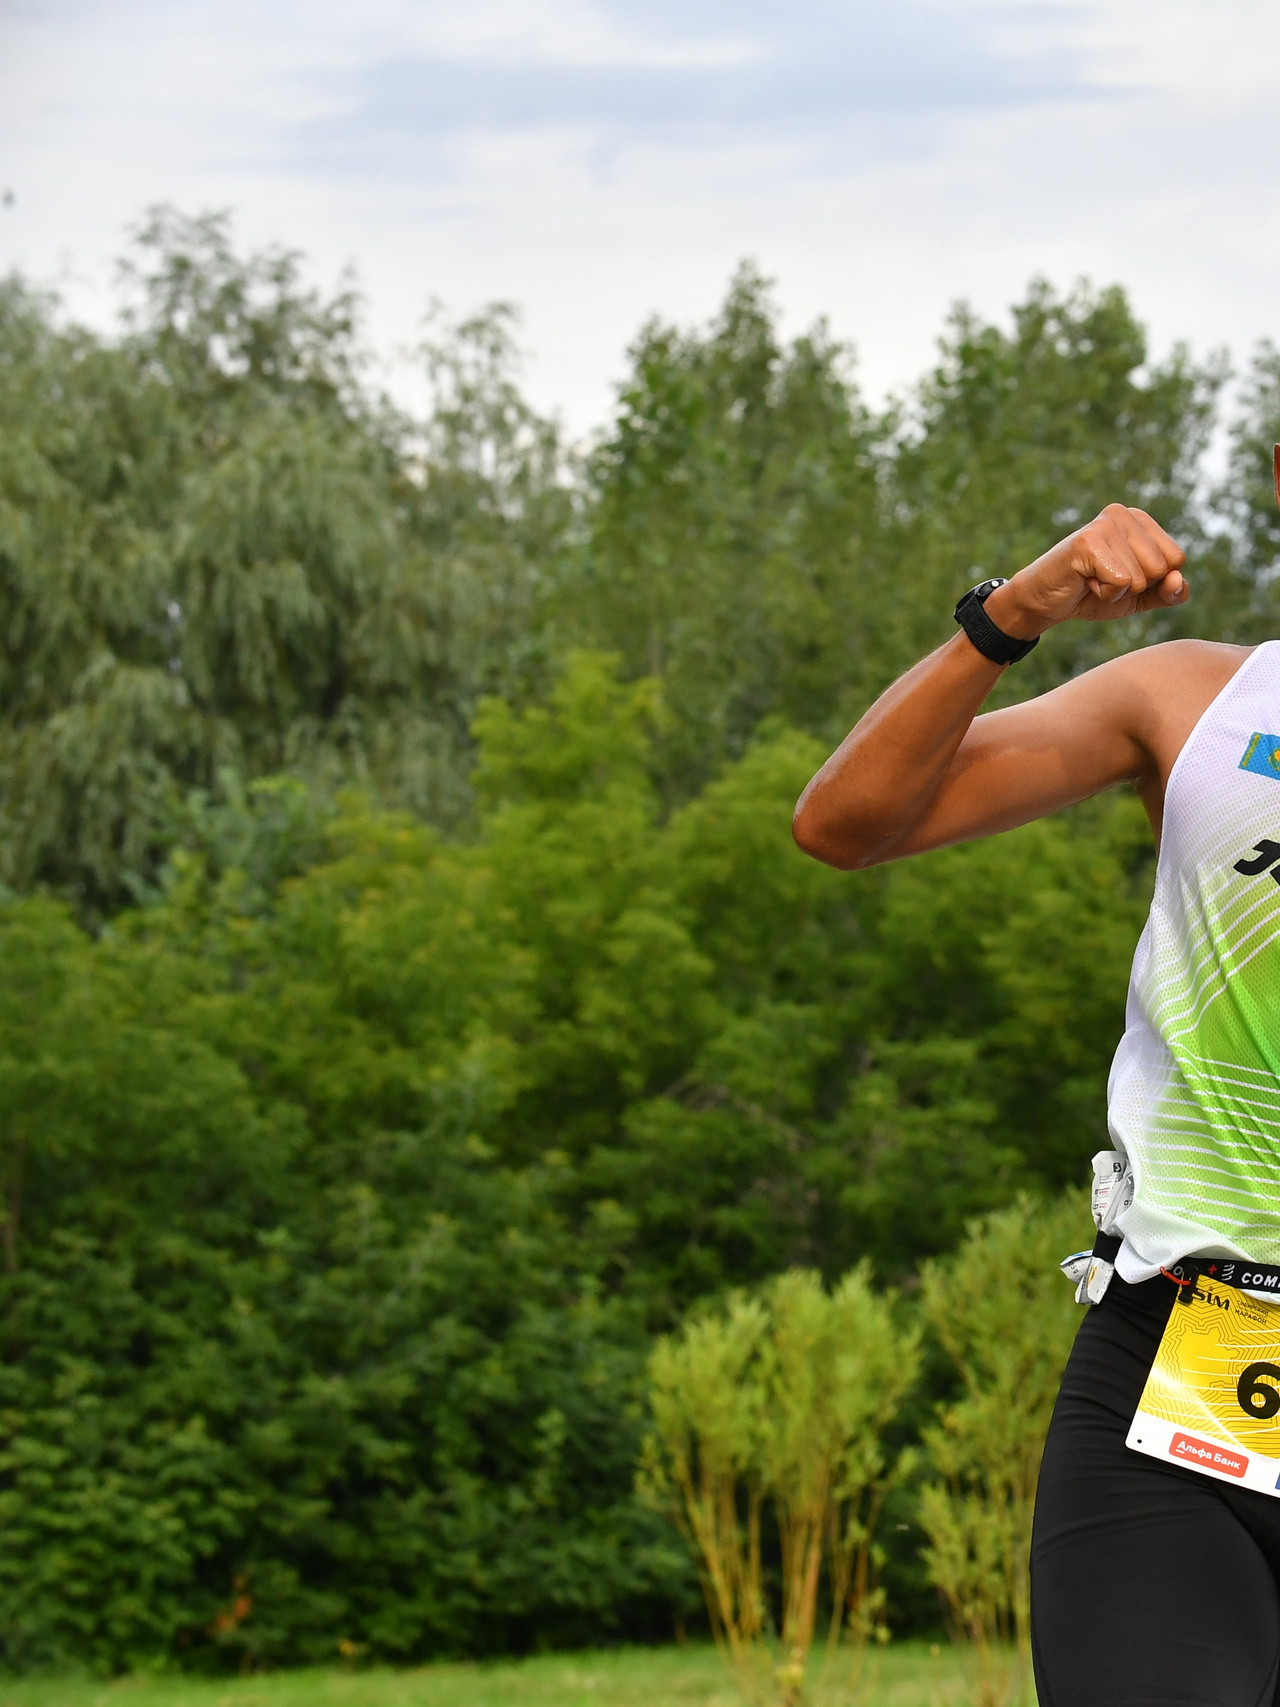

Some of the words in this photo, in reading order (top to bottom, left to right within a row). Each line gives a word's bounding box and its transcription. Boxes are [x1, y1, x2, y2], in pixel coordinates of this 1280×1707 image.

[1235, 1308, 1268, 1325] МАРАФОН
[1176, 1440, 1213, 1459] Альфа
[1213, 1453, 1241, 1470] Банк
